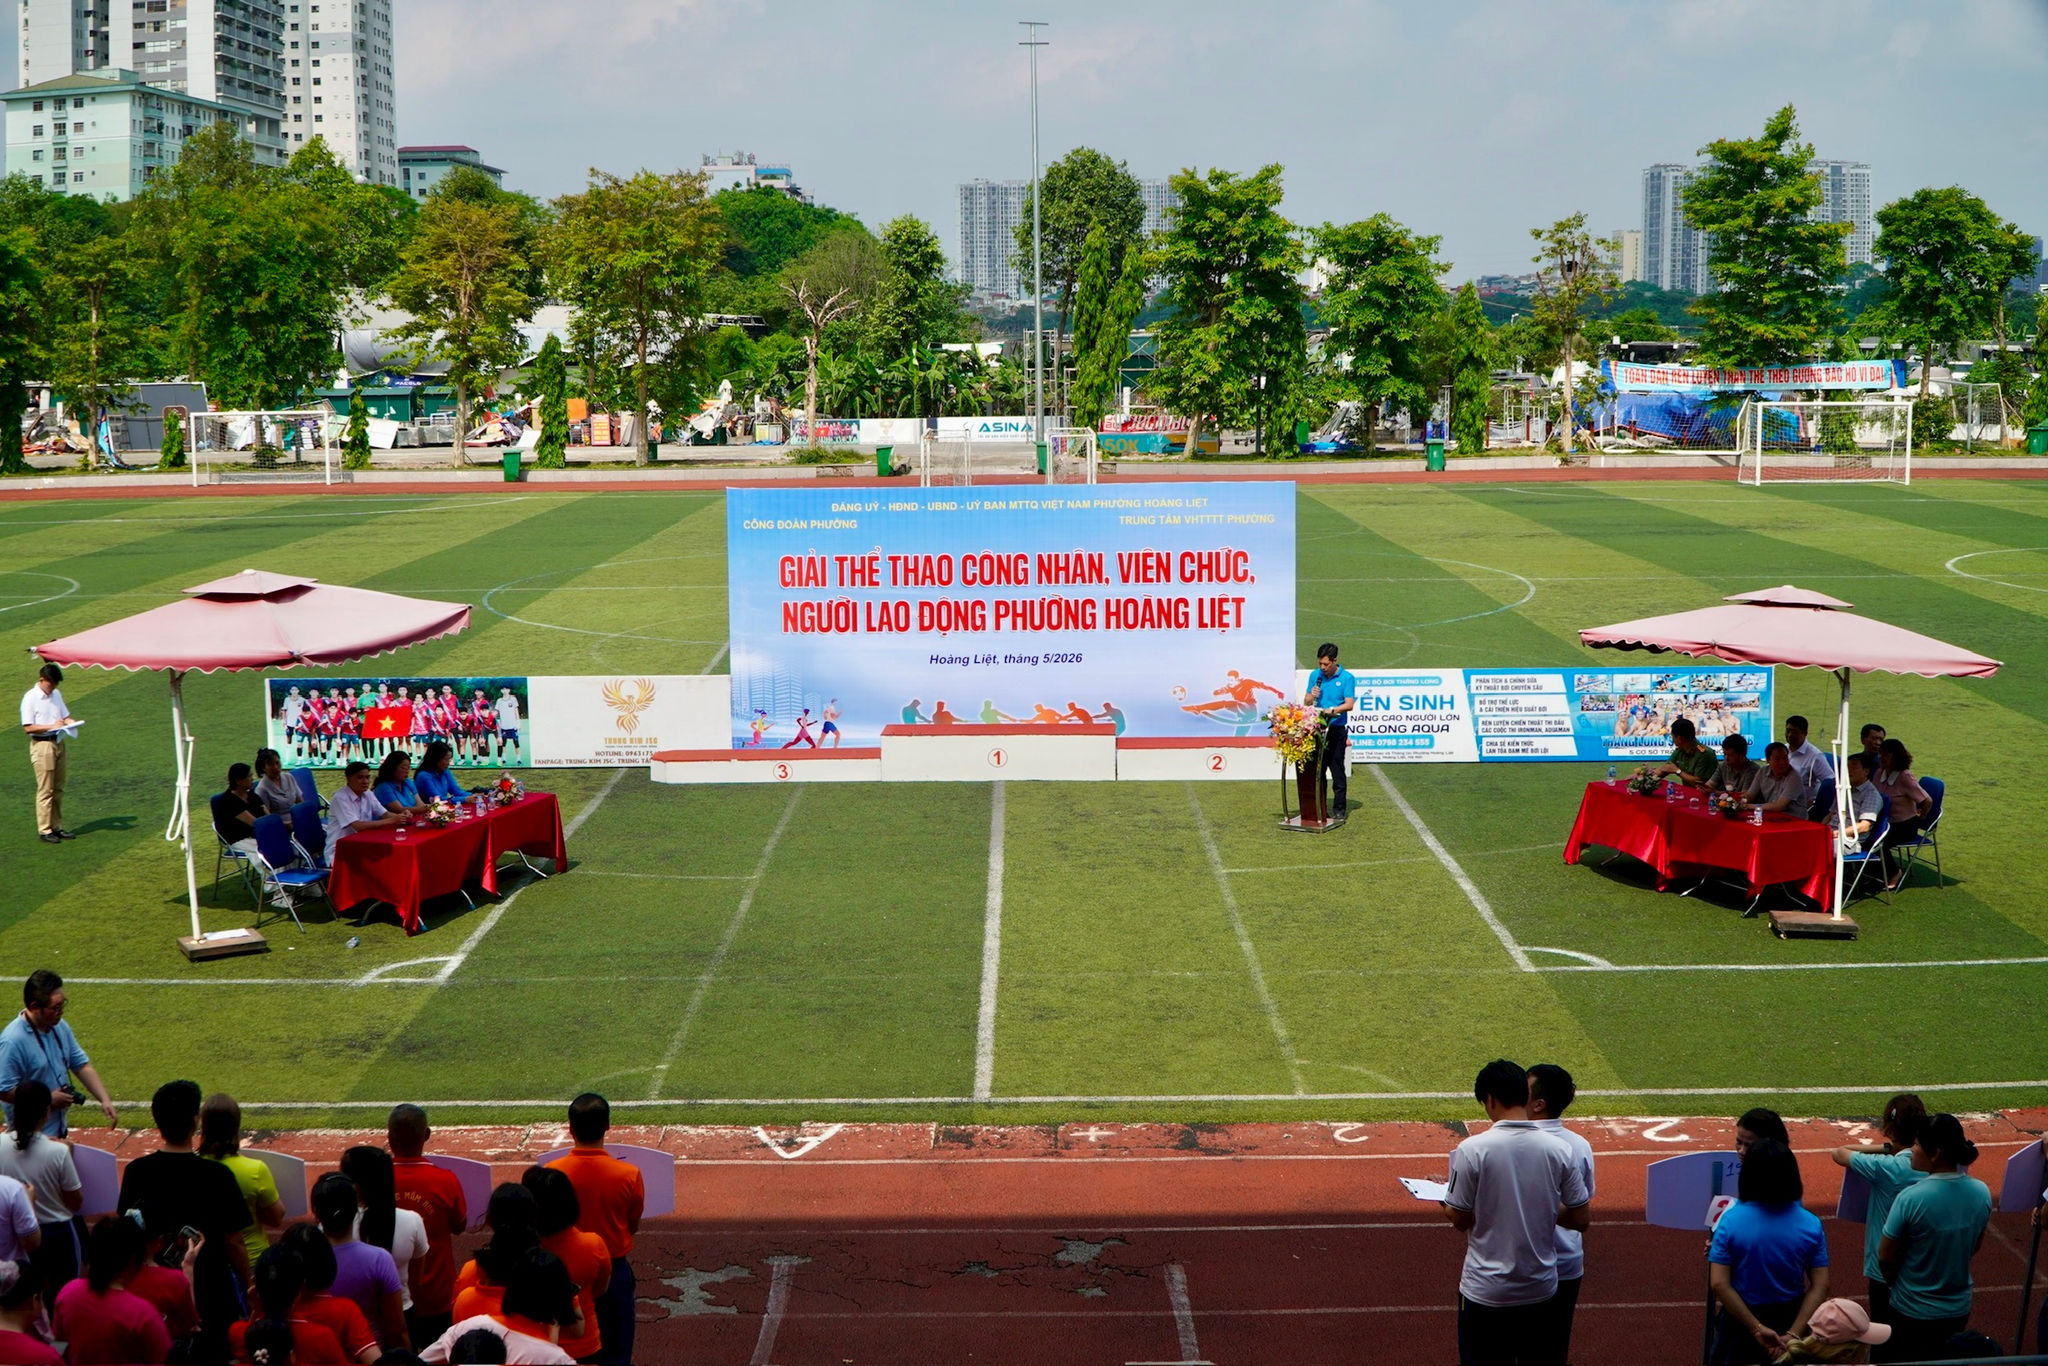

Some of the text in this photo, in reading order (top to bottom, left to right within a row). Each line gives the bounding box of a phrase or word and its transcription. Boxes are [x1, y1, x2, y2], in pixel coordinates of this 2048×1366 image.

[1768, 368, 1790, 383] THEO
[1825, 364, 1843, 382] BÁC
[978, 422, 1034, 432] ASINA
[831, 501, 862, 512] ĐẢNG
[888, 502, 919, 511] HĐND
[927, 502, 957, 511] UBND
[983, 501, 1006, 510] BAN
[1009, 500, 1038, 510] MTTQ
[1041, 498, 1064, 510] VIỆT
[1067, 500, 1091, 509] NAM
[1093, 497, 1141, 508] PHƯỜNG
[1144, 497, 1183, 508] HOÀNG
[1185, 497, 1208, 509] LIỆT
[743, 517, 858, 530] CÔNG ĐOÀN PHƯỜNG
[1119, 512, 1275, 525] TRUNG TÂM VHTTTT PHƯỜNG
[778, 546, 1256, 588] GIẢI THỂ THAO CÔNG NHÂN, VIÊN CHỨC,
[782, 593, 1246, 637] NGƯỜI LAO ĐỘNG PHƯỜNG HOÀNG LIỆT
[929, 652, 1083, 667] Hoàng Liệt, tháng 5/2026
[1353, 689, 1455, 711] ỂN SINH
[1405, 712, 1437, 721] NGƯỜI
[1439, 713, 1460, 721] LỚN
[1345, 724, 1450, 734] NG LONG AQUA
[1352, 738, 1375, 747] TLINE:
[1637, 736, 1665, 747] LONG
[993, 750, 1001, 765] 1
[1212, 755, 1222, 770] 2
[778, 764, 788, 779] 3
